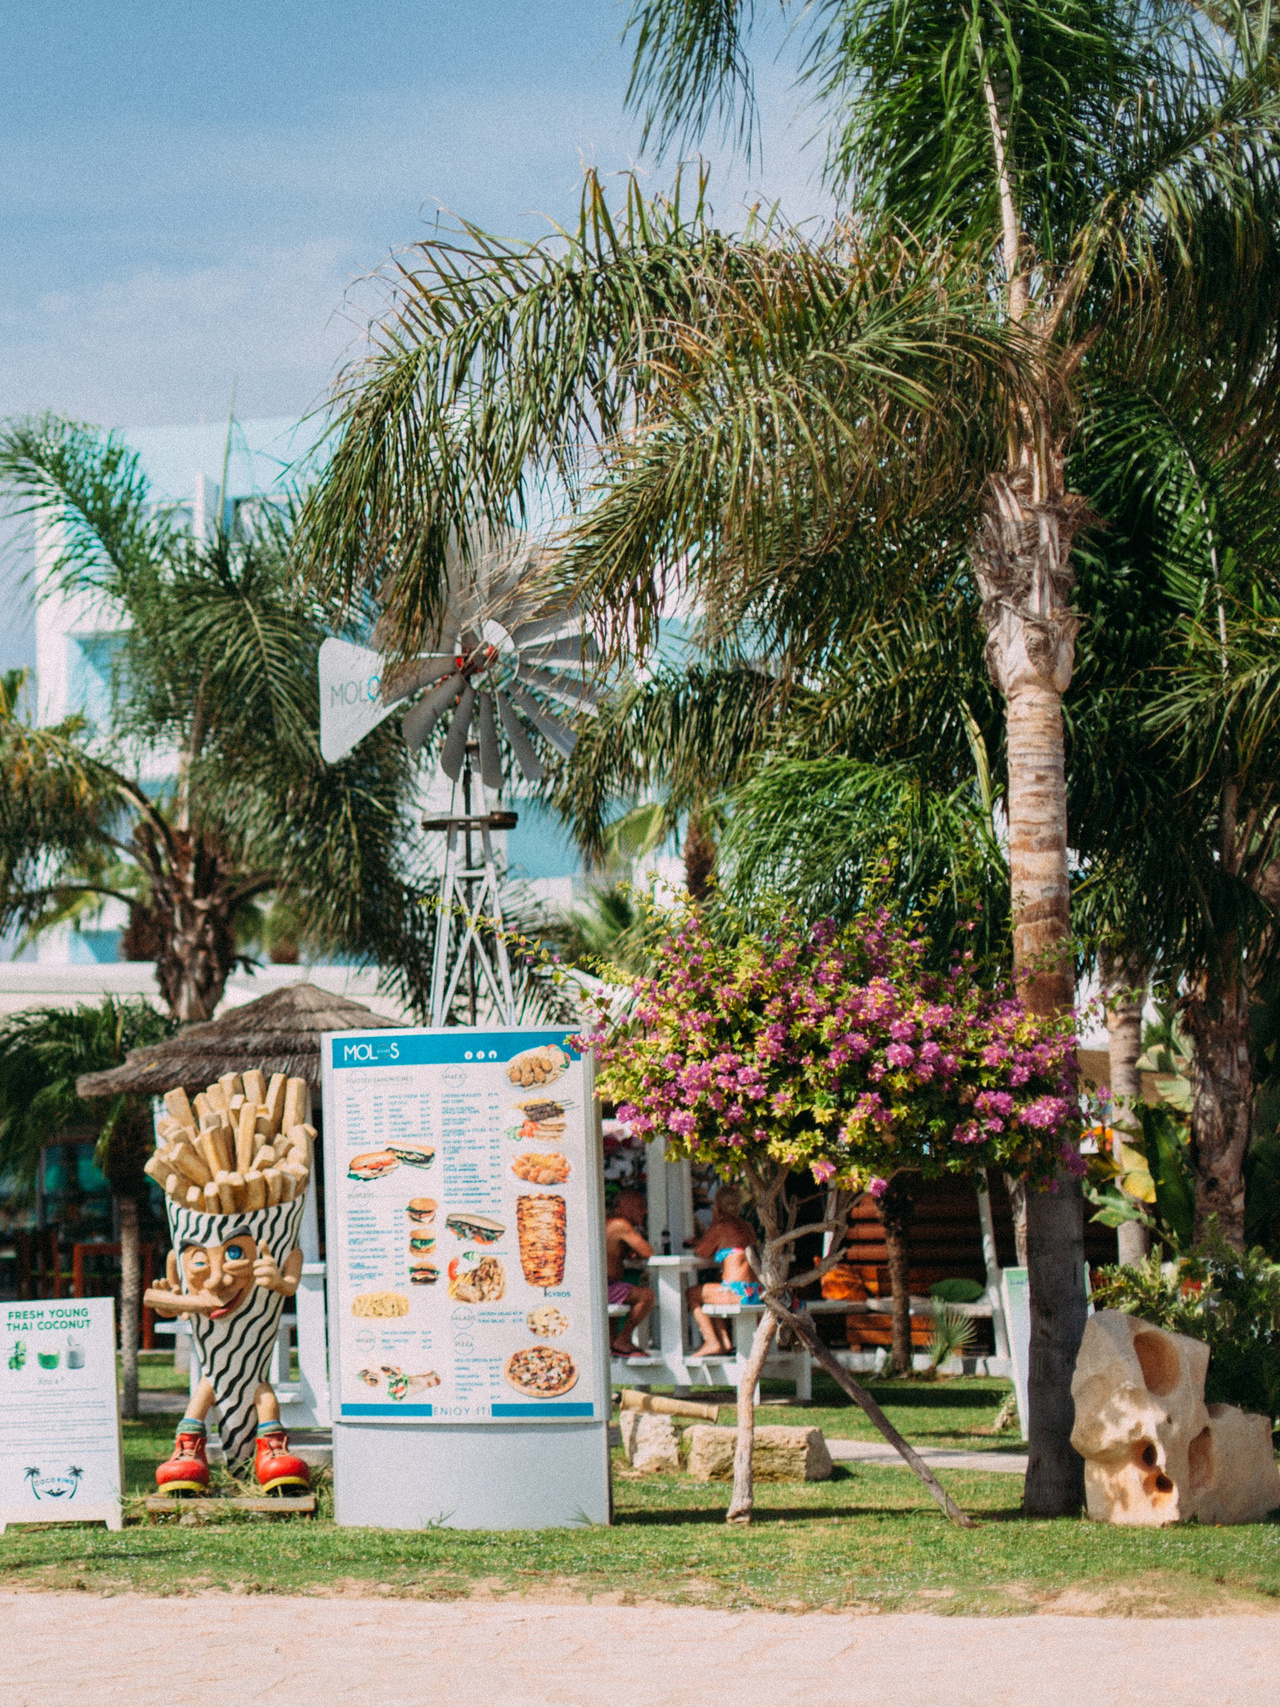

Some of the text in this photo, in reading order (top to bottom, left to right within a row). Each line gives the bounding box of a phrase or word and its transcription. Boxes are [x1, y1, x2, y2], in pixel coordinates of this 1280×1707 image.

[330, 675, 381, 708] MOLO
[7, 1307, 89, 1320] FRESH YOUNG
[6, 1319, 91, 1332] THAI COCONUT
[433, 1406, 471, 1416] ENJOY
